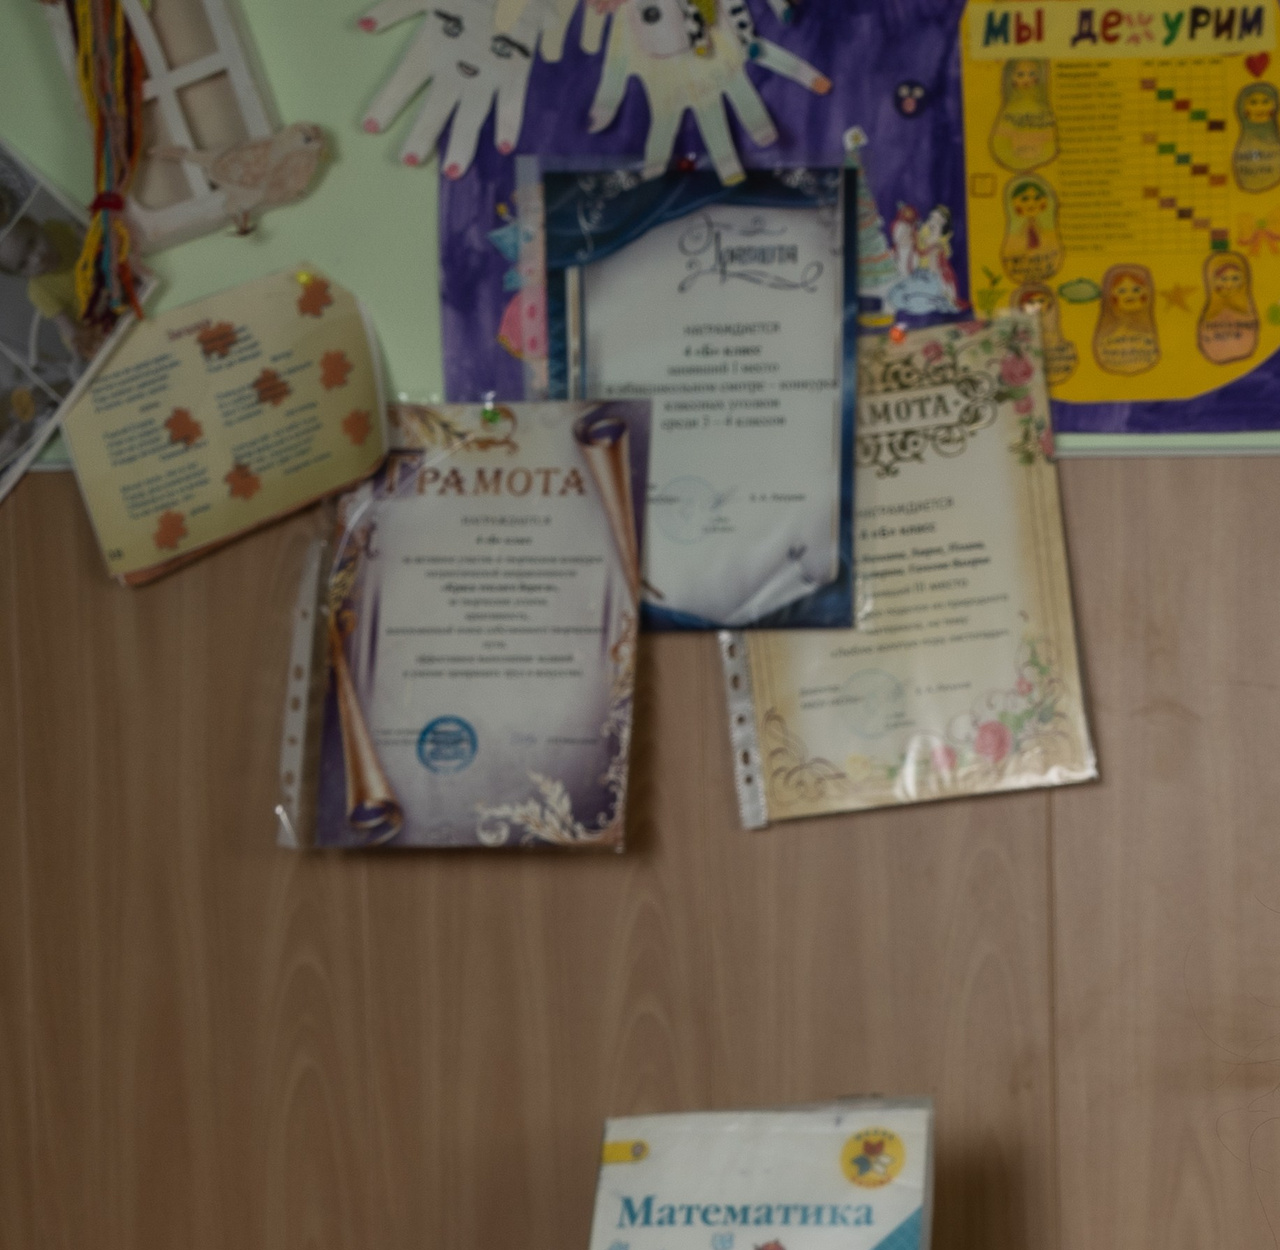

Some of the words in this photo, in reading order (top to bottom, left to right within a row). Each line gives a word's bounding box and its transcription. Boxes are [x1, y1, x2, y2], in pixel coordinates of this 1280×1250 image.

[983, 9, 1043, 46] МЫ
[858, 394, 952, 426] МОТА
[386, 452, 586, 497] ГРАМОТА
[617, 1196, 874, 1229] Математика
